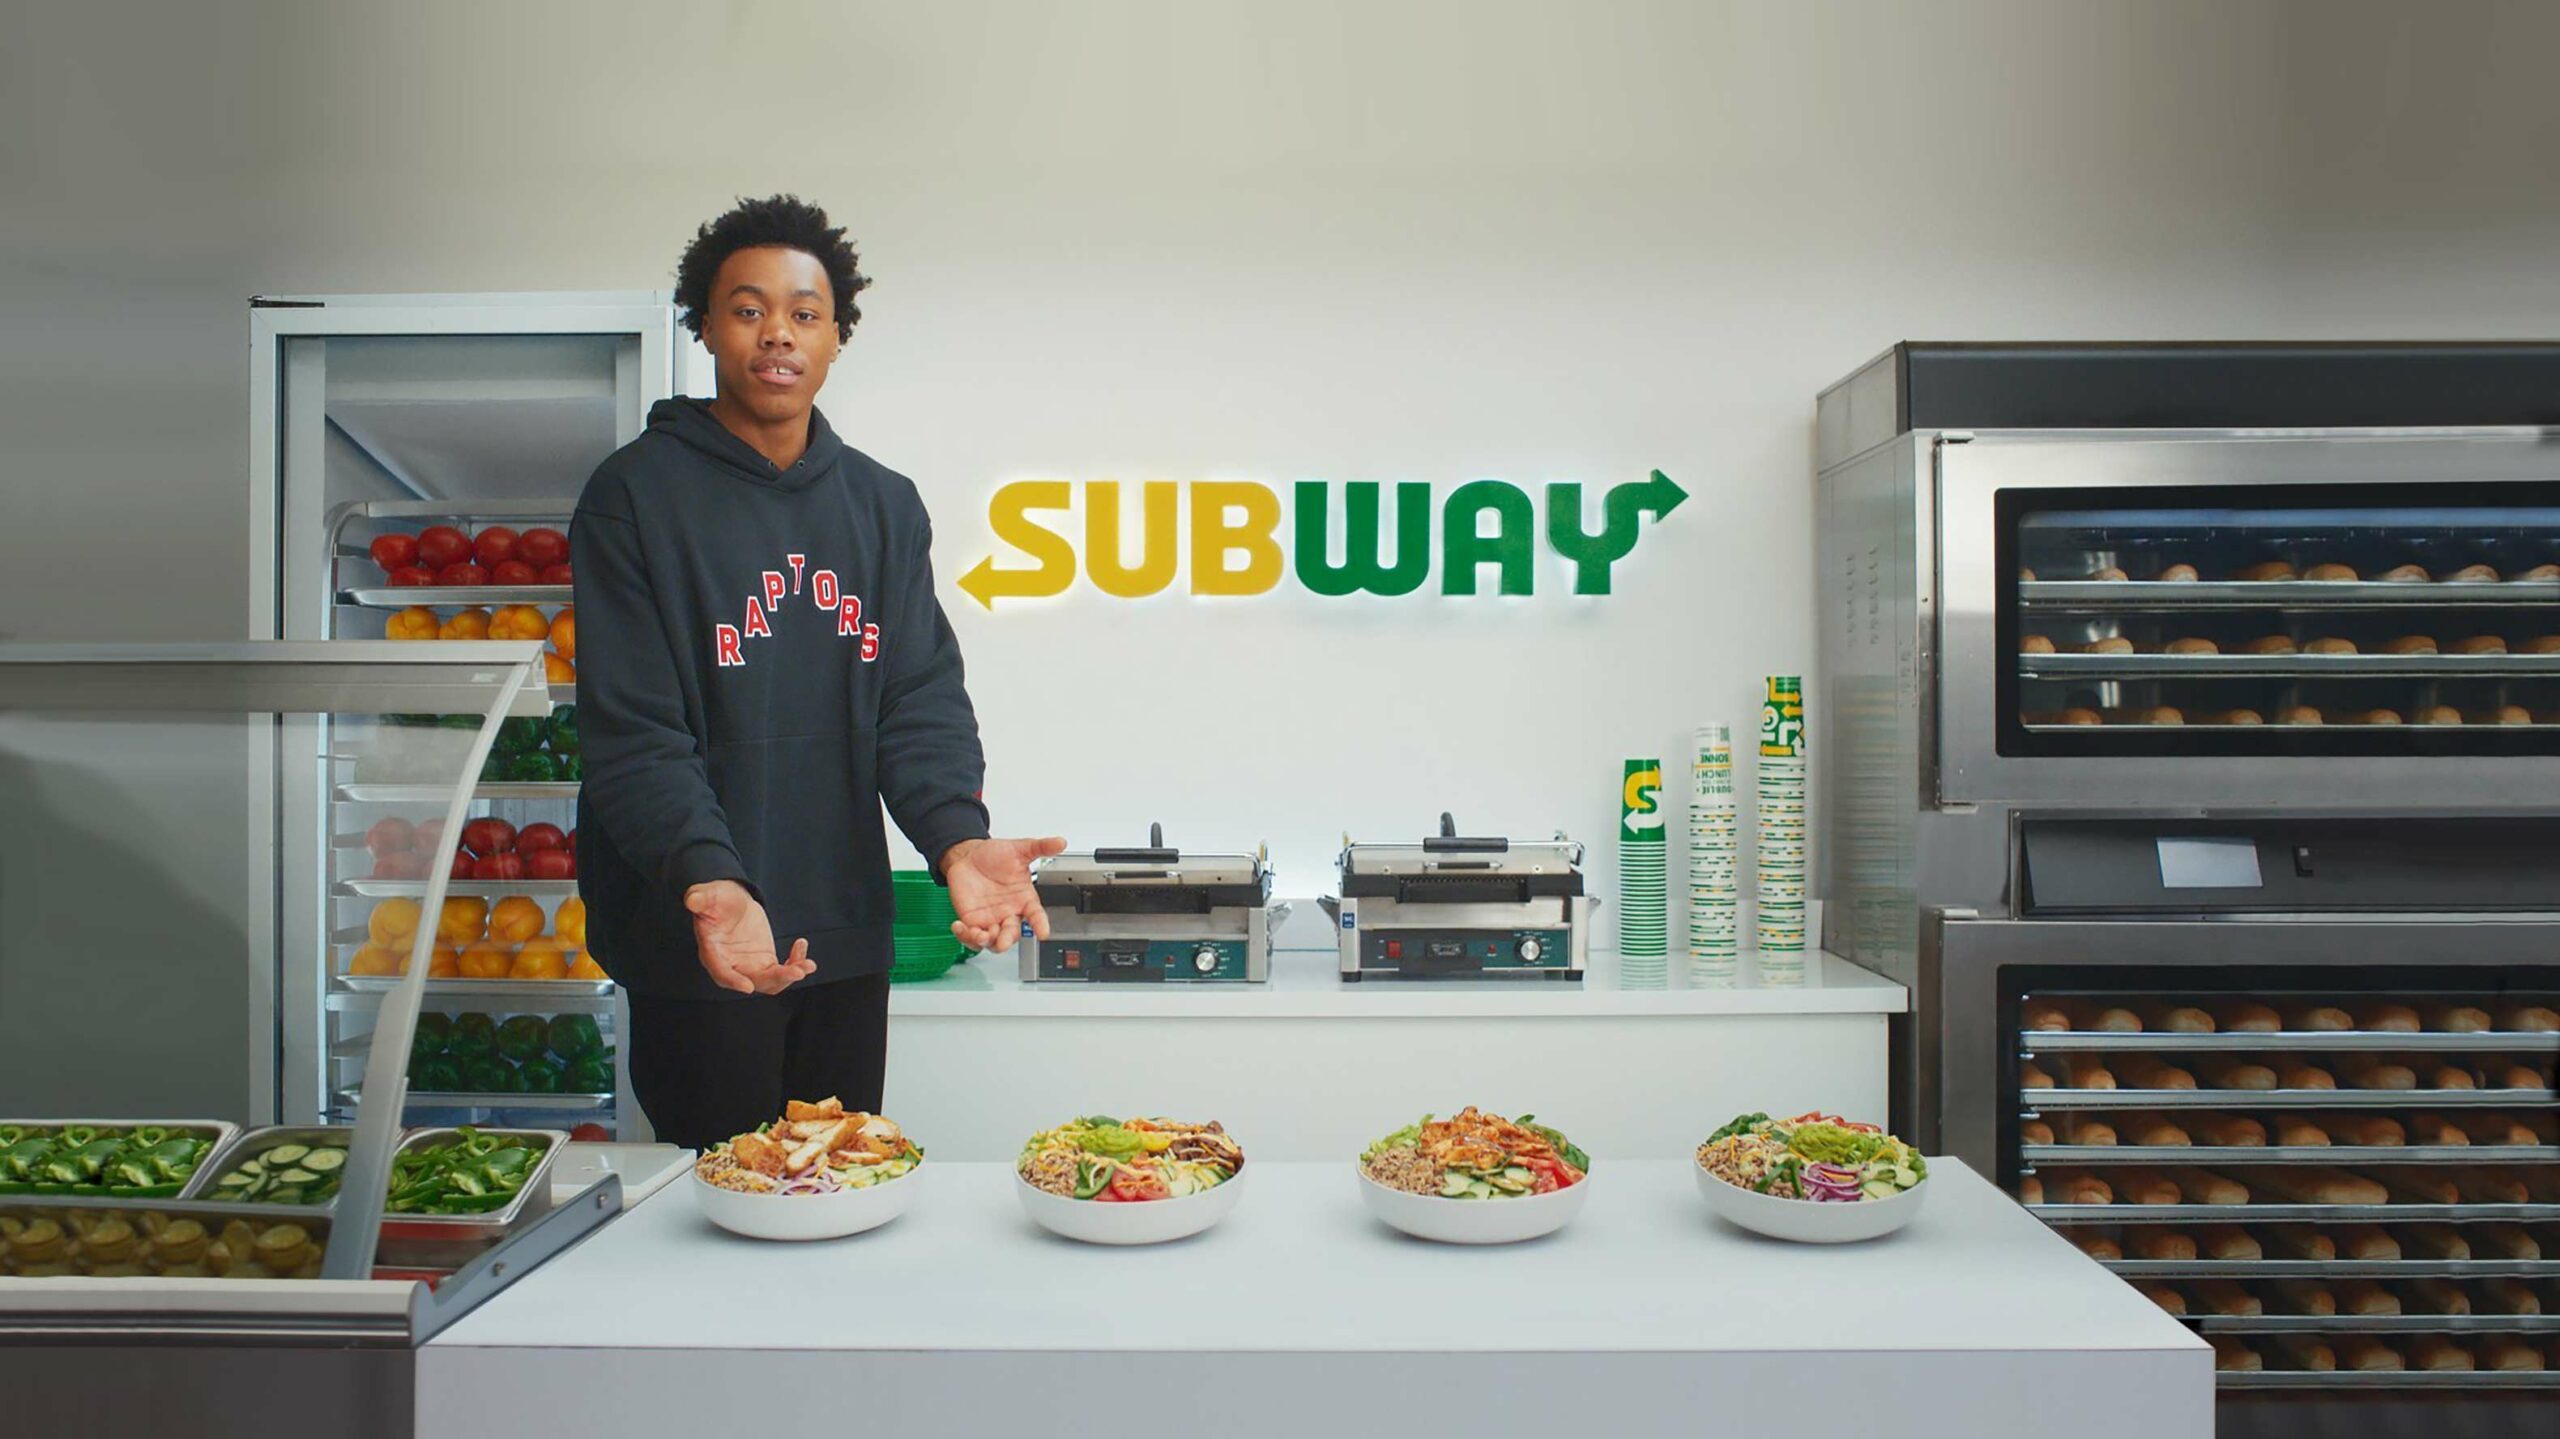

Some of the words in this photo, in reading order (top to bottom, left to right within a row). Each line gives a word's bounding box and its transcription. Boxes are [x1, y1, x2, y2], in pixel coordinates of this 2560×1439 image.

[956, 469, 1690, 611] SUBWAY
[716, 554, 880, 666] RAPTORS
[1700, 753, 1729, 763] BONNE
